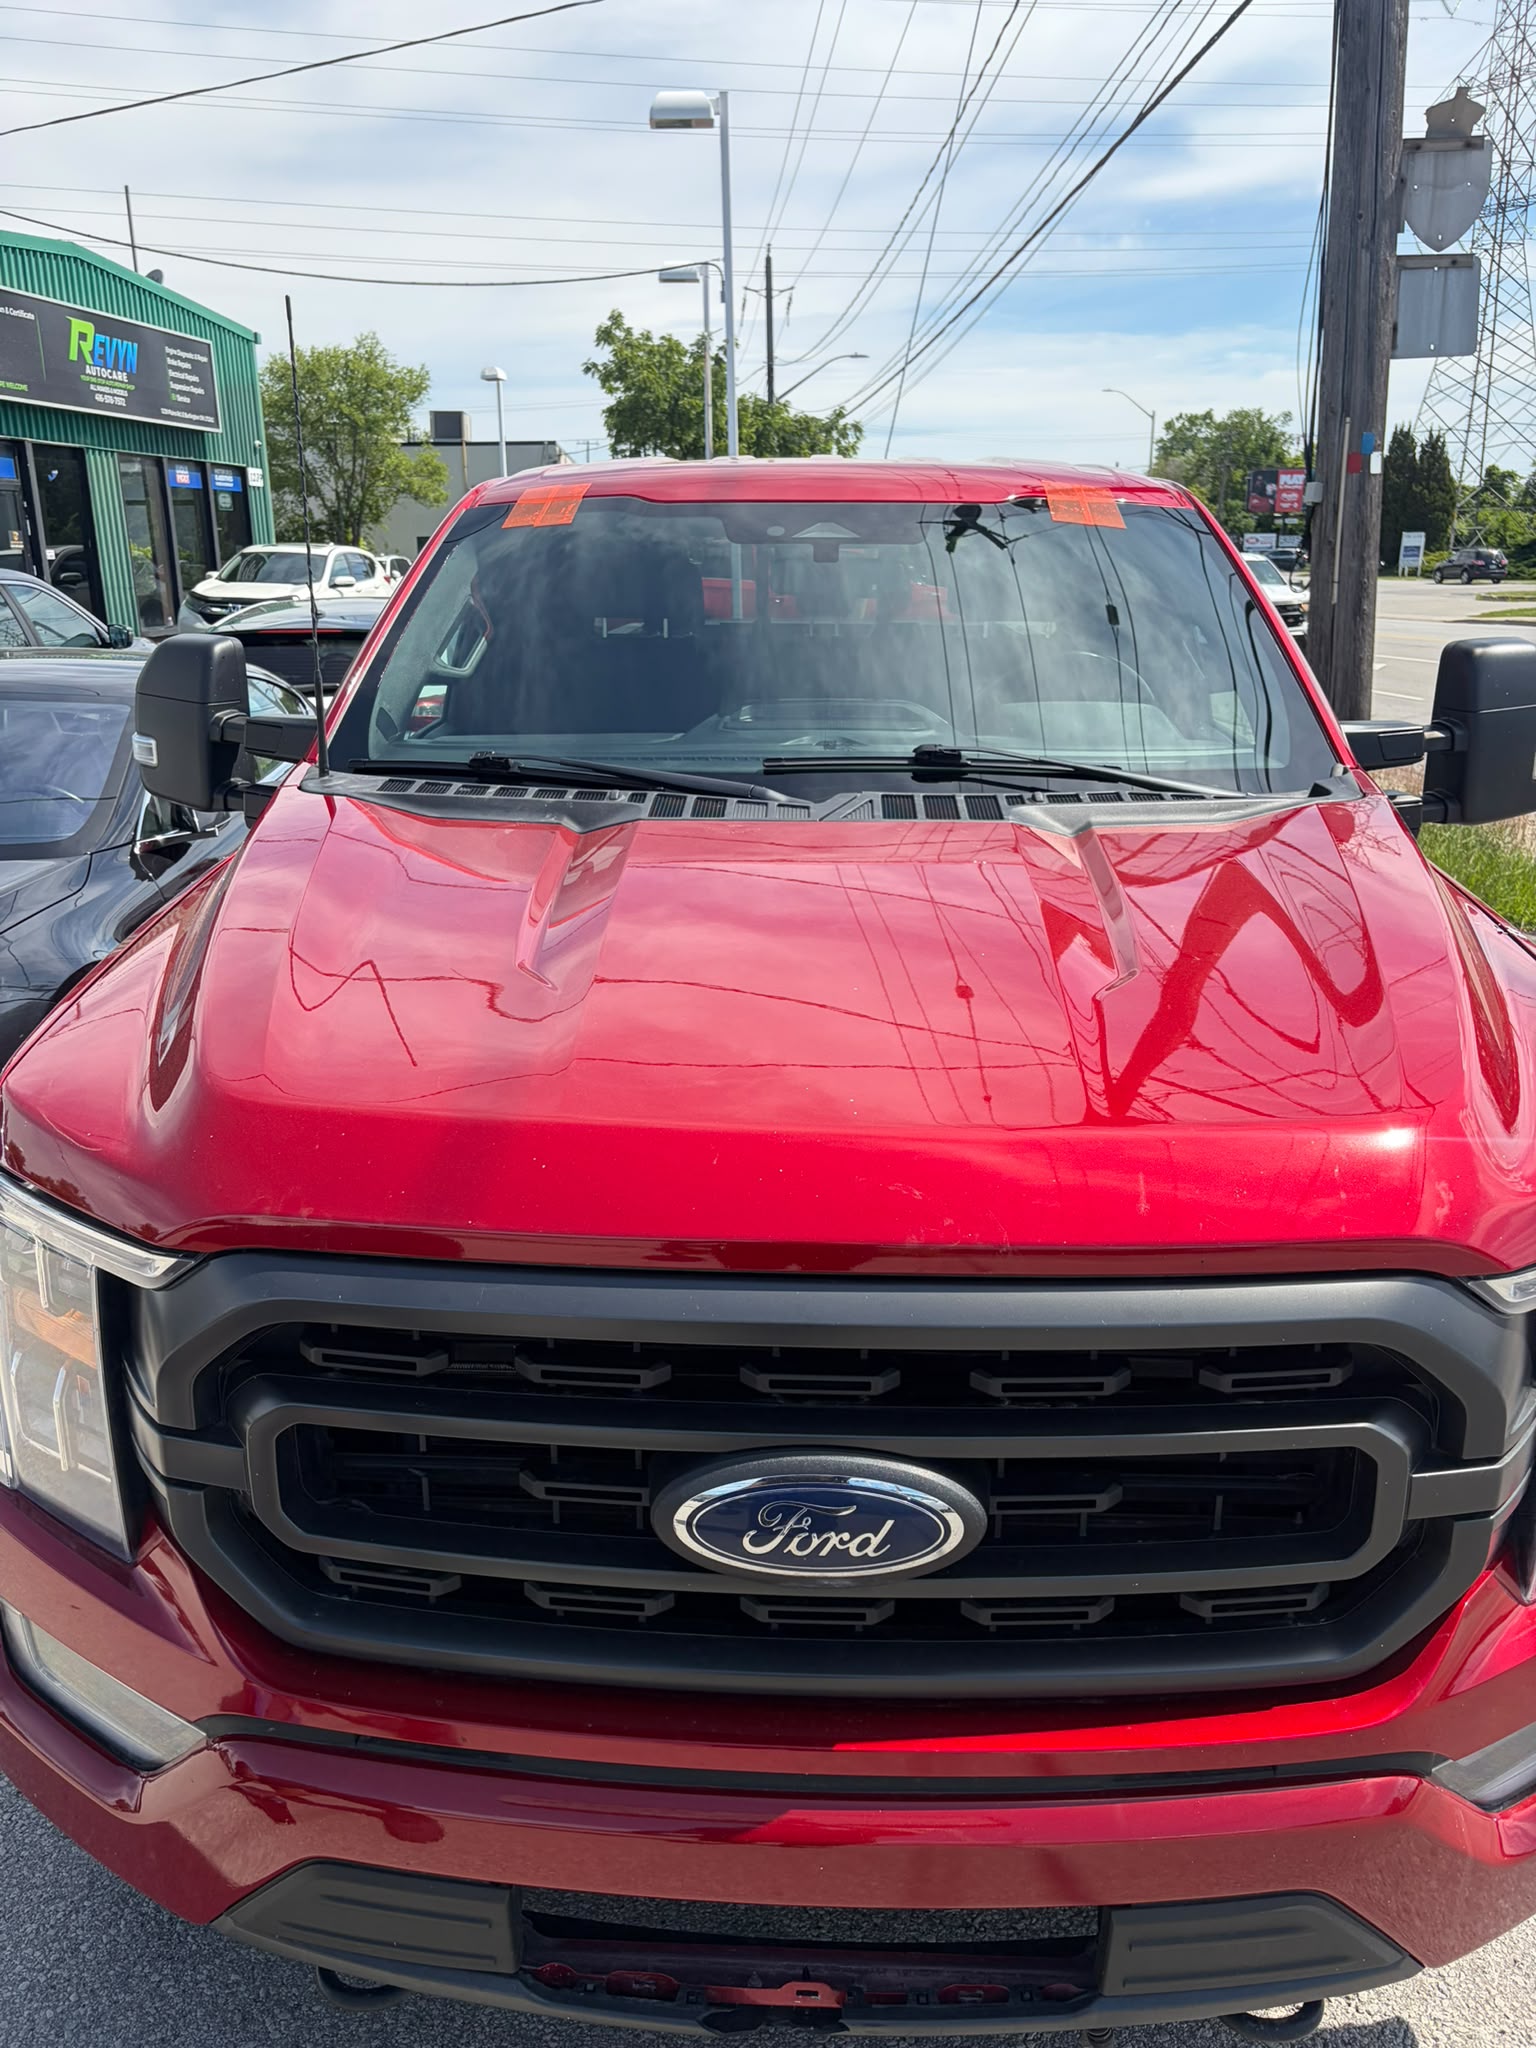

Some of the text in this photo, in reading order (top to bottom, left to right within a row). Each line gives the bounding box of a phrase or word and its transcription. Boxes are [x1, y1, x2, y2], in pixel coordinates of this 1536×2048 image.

[65, 315, 138, 375] REVYN
[85, 364, 129, 383] AUTOCARE
[742, 1500, 895, 1557] Ford
